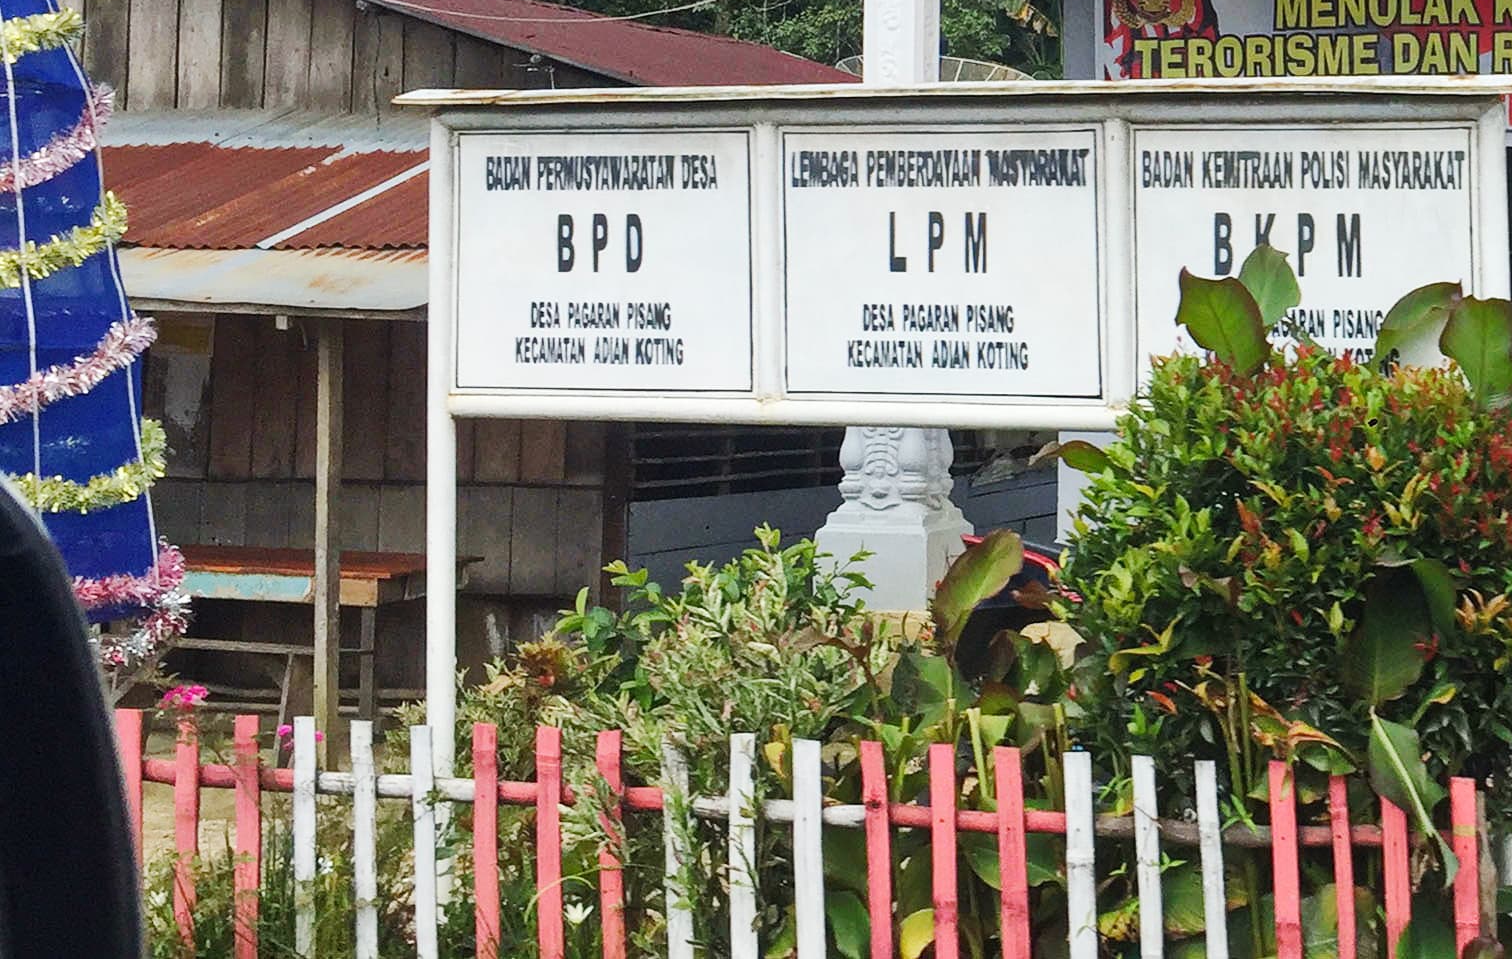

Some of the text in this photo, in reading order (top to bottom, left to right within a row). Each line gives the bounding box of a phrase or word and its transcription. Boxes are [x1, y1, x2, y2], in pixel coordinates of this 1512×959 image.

[1134, 33, 1379, 78] TERORISME
[1393, 31, 1480, 74] DAN
[486, 155, 719, 190] BADAN PERMUSYAWARATAN DESA
[792, 149, 1090, 188] LEMBAGA PEMBERDAYAAN MASYARAKAT
[1142, 151, 1465, 190] BADAN KEMITRAAN POLISI MASYARAKAT
[530, 302, 671, 330] DESA PAGARAN PISANG
[863, 304, 1014, 334] DESA PAGARAN PISANG
[515, 337, 683, 366] KECAMATAN ADIAN KOTING
[848, 340, 1029, 370] KECAMATAN ADIAN KOTING
